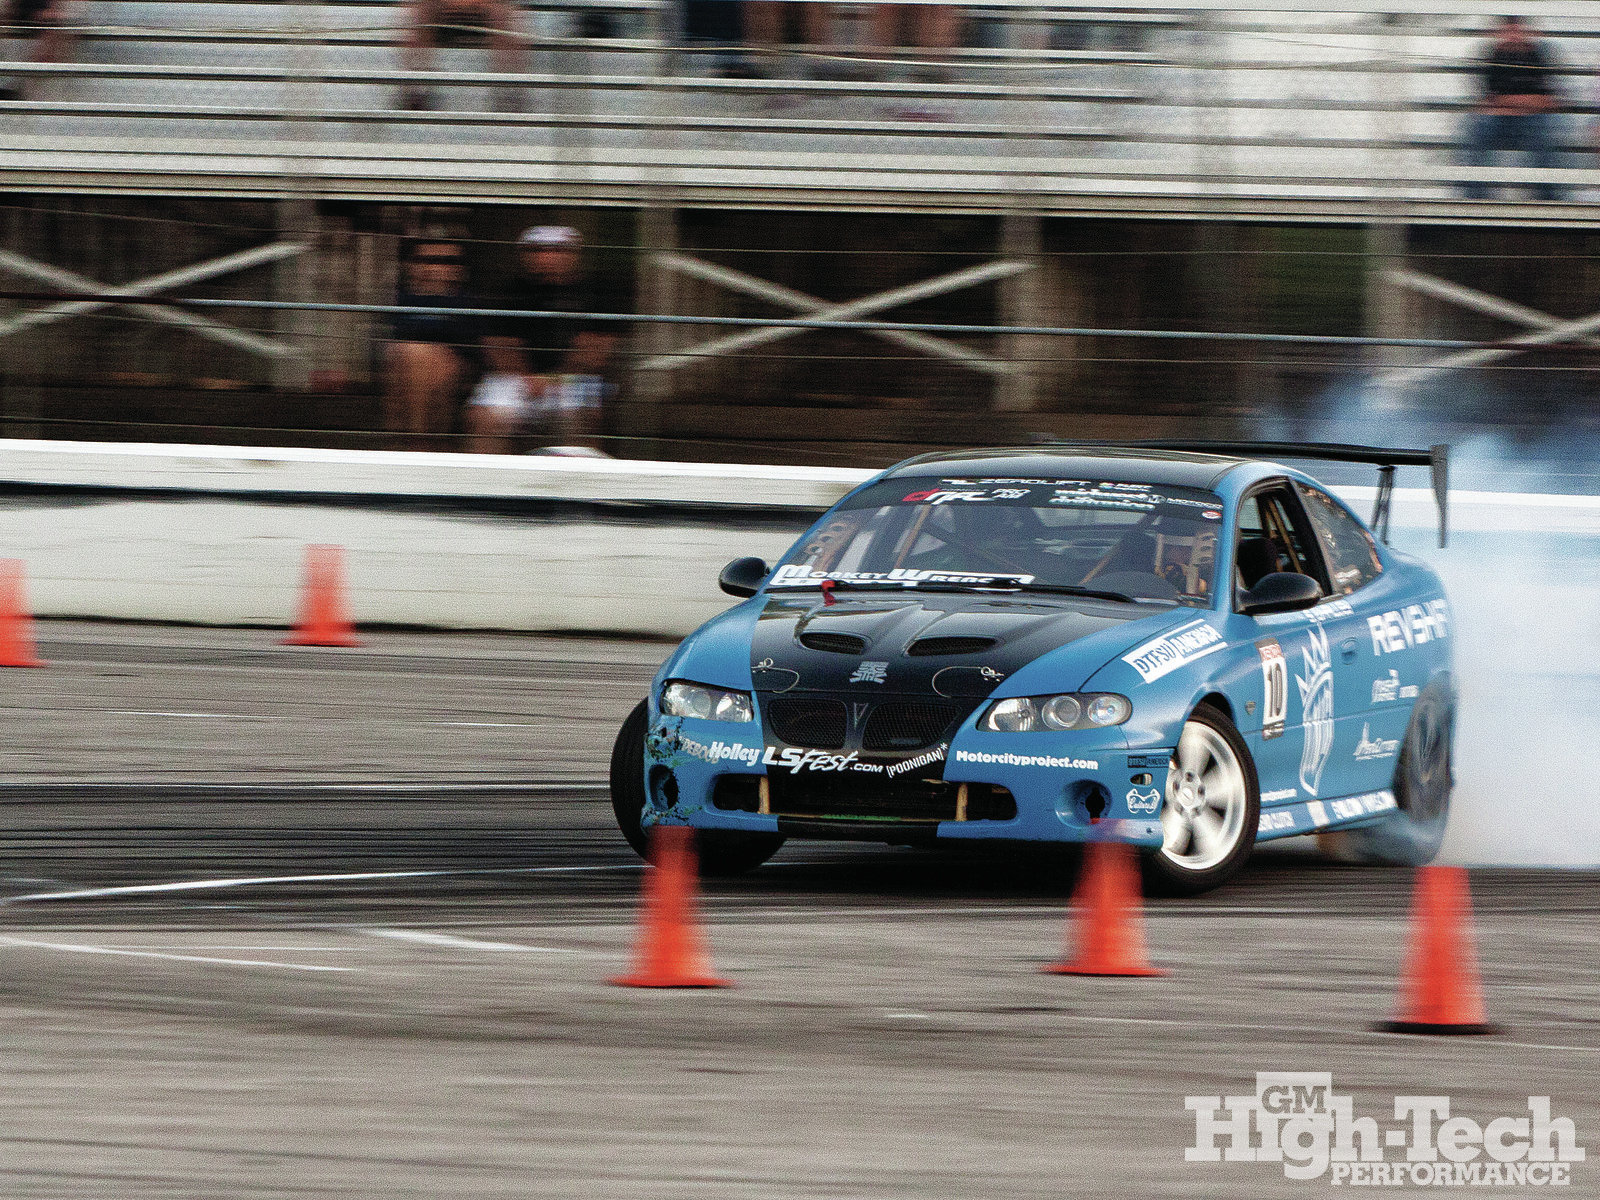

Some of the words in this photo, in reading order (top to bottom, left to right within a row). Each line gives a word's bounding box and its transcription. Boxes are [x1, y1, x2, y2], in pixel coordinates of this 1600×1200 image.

[1267, 663, 1284, 717] 10
[709, 741, 760, 767] Holley
[956, 750, 1099, 769] Motorcityproject.com
